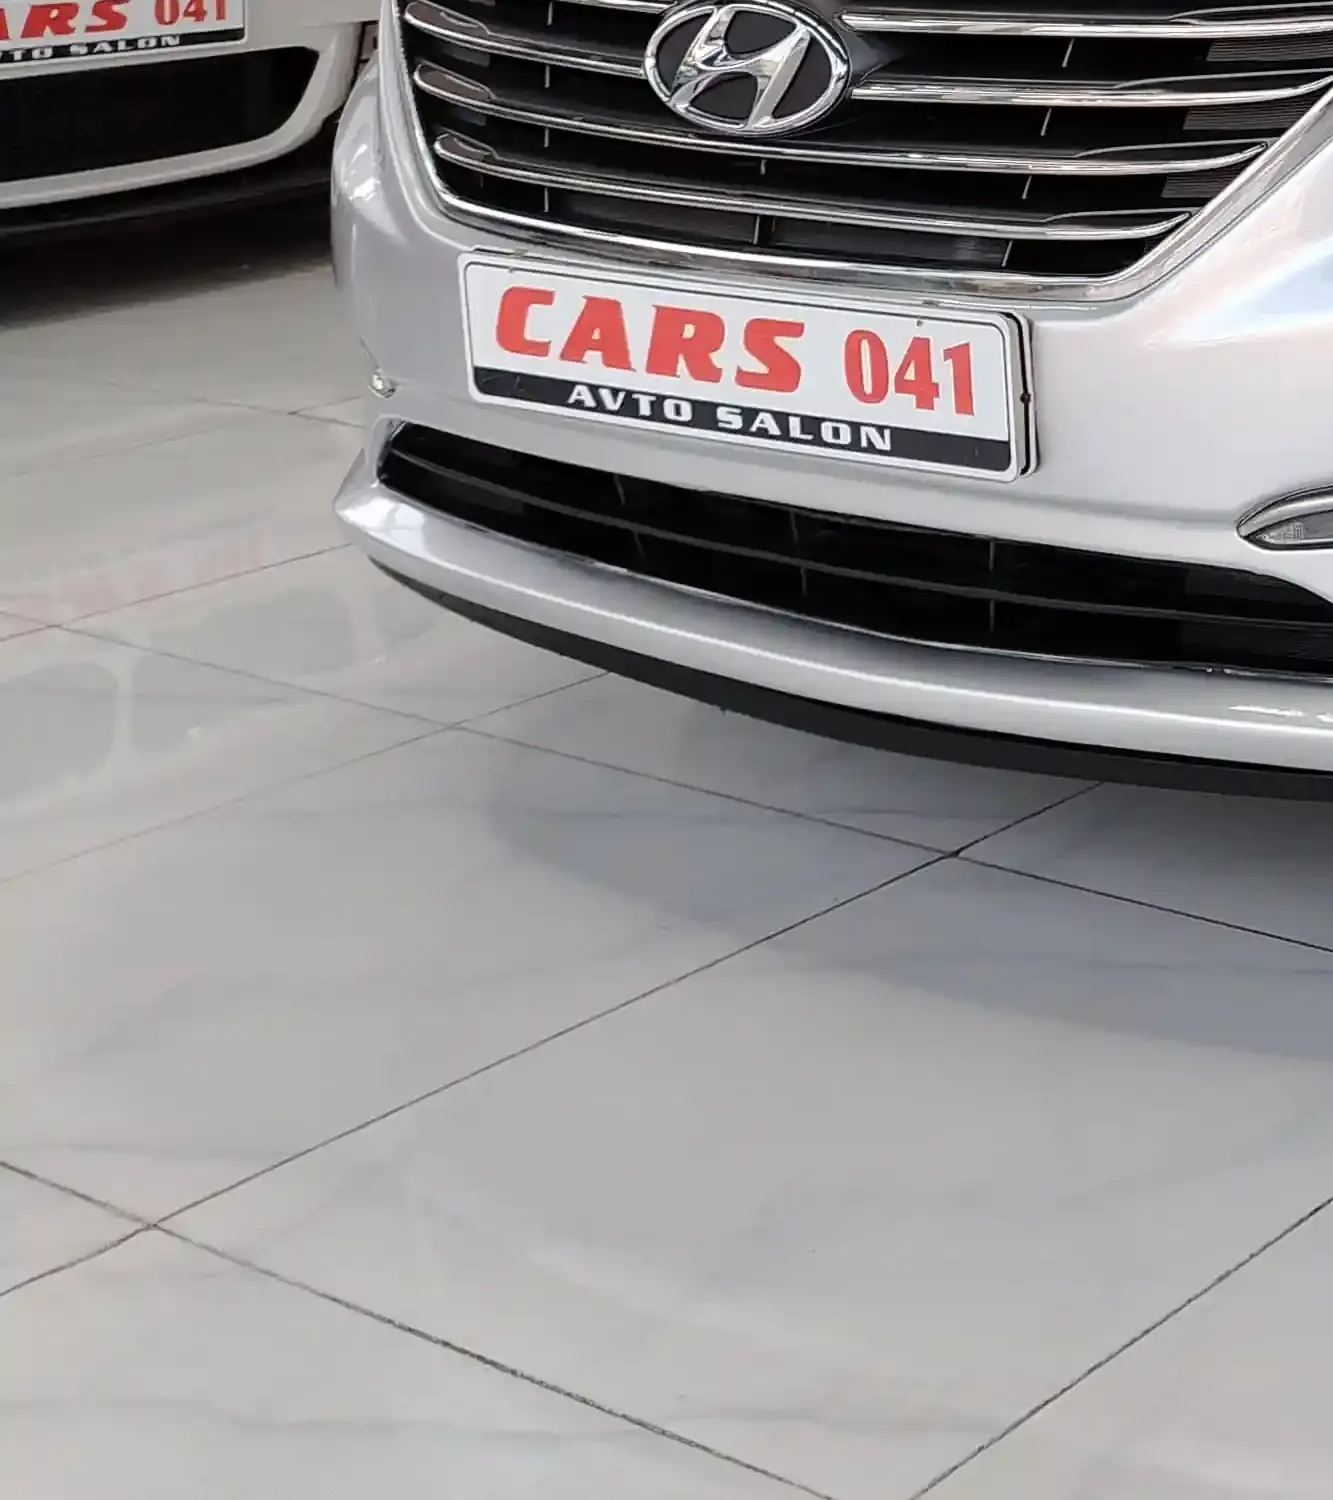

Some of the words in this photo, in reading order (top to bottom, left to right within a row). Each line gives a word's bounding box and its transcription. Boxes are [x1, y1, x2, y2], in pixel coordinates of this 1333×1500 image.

[0, 47, 53, 61] TO
[69, 35, 180, 56] SALON
[496, 285, 804, 394] CARS
[843, 328, 975, 416] 041
[567, 383, 693, 422] AVTO
[716, 405, 892, 451] SALON
